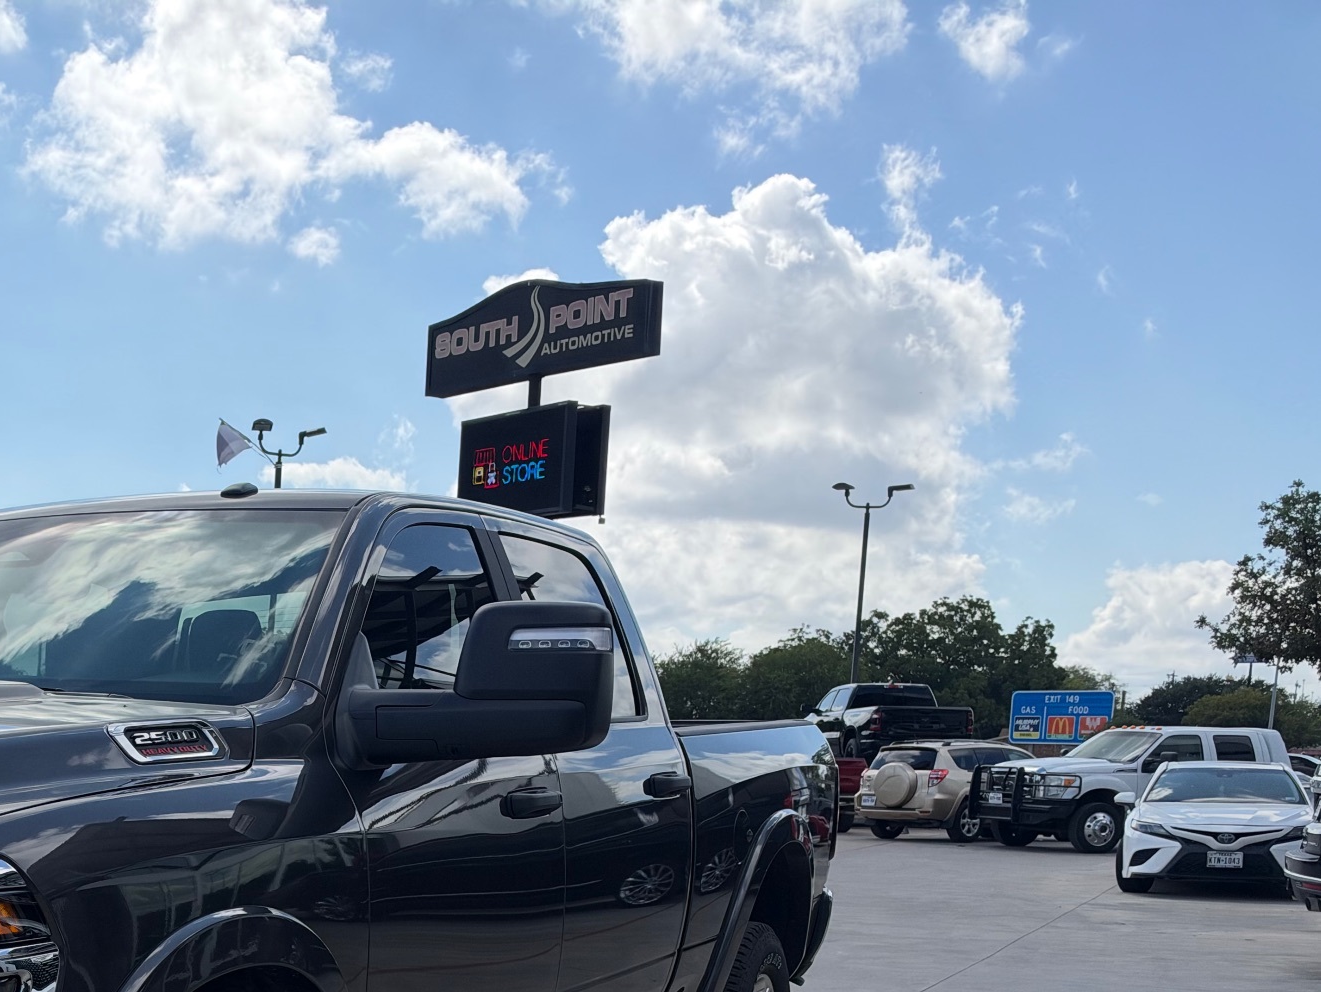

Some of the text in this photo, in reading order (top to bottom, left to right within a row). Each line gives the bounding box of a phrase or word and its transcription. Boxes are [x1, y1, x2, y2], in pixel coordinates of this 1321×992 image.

[435, 288, 634, 359] SOUTH POINT
[540, 324, 634, 356] AUTOMOTIVE
[502, 438, 550, 464] ONLINE
[502, 460, 546, 485] STORE
[1045, 695, 1080, 703] EXIT 149
[1021, 706, 1089, 714] GAS FOOD
[133, 729, 199, 745] 2500
[141, 745, 207, 756] HEAVY DUTY
